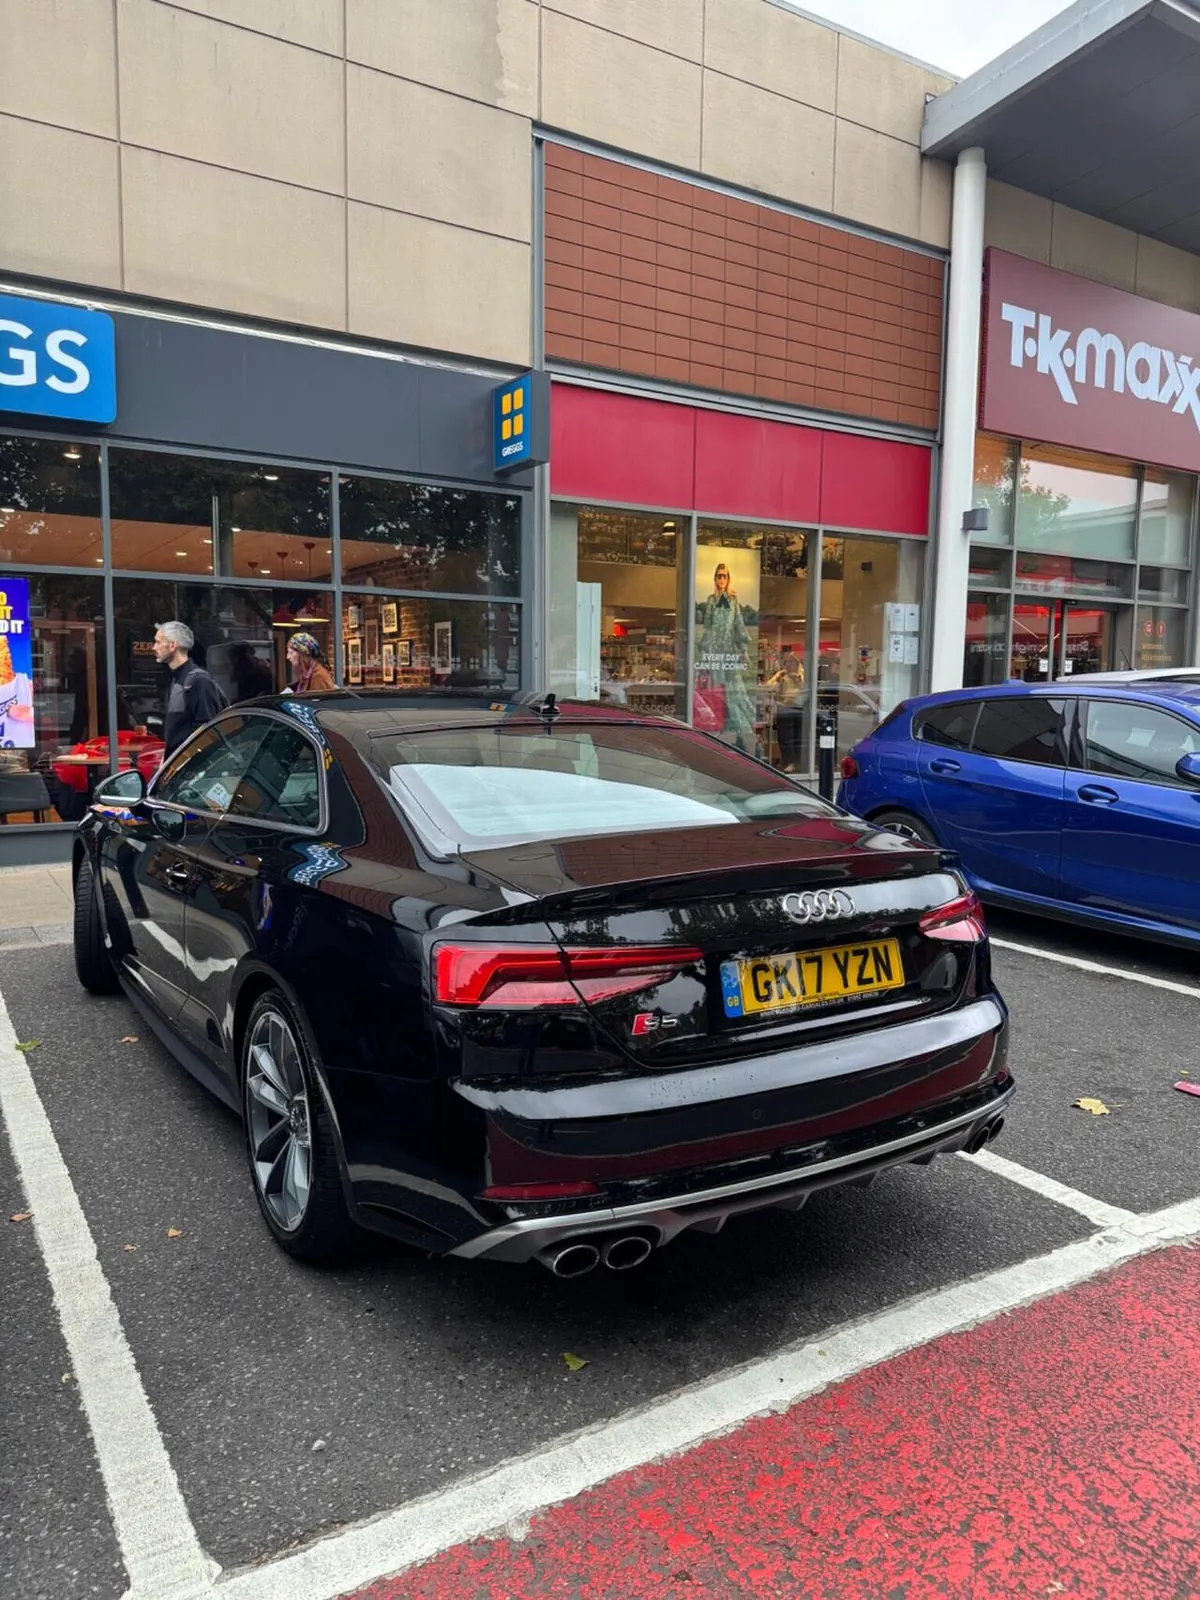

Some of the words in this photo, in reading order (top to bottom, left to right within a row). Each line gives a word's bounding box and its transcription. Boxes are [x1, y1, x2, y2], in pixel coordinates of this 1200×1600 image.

[702, 653, 724, 661] EVERY
[726, 653, 740, 661] DAY
[694, 662, 709, 671] CAN
[711, 662, 720, 671] BE
[722, 662, 748, 671] ICONIC
[751, 954, 823, 1004] GK17
[833, 944, 894, 989] YZN
[727, 995, 740, 1007] GB
